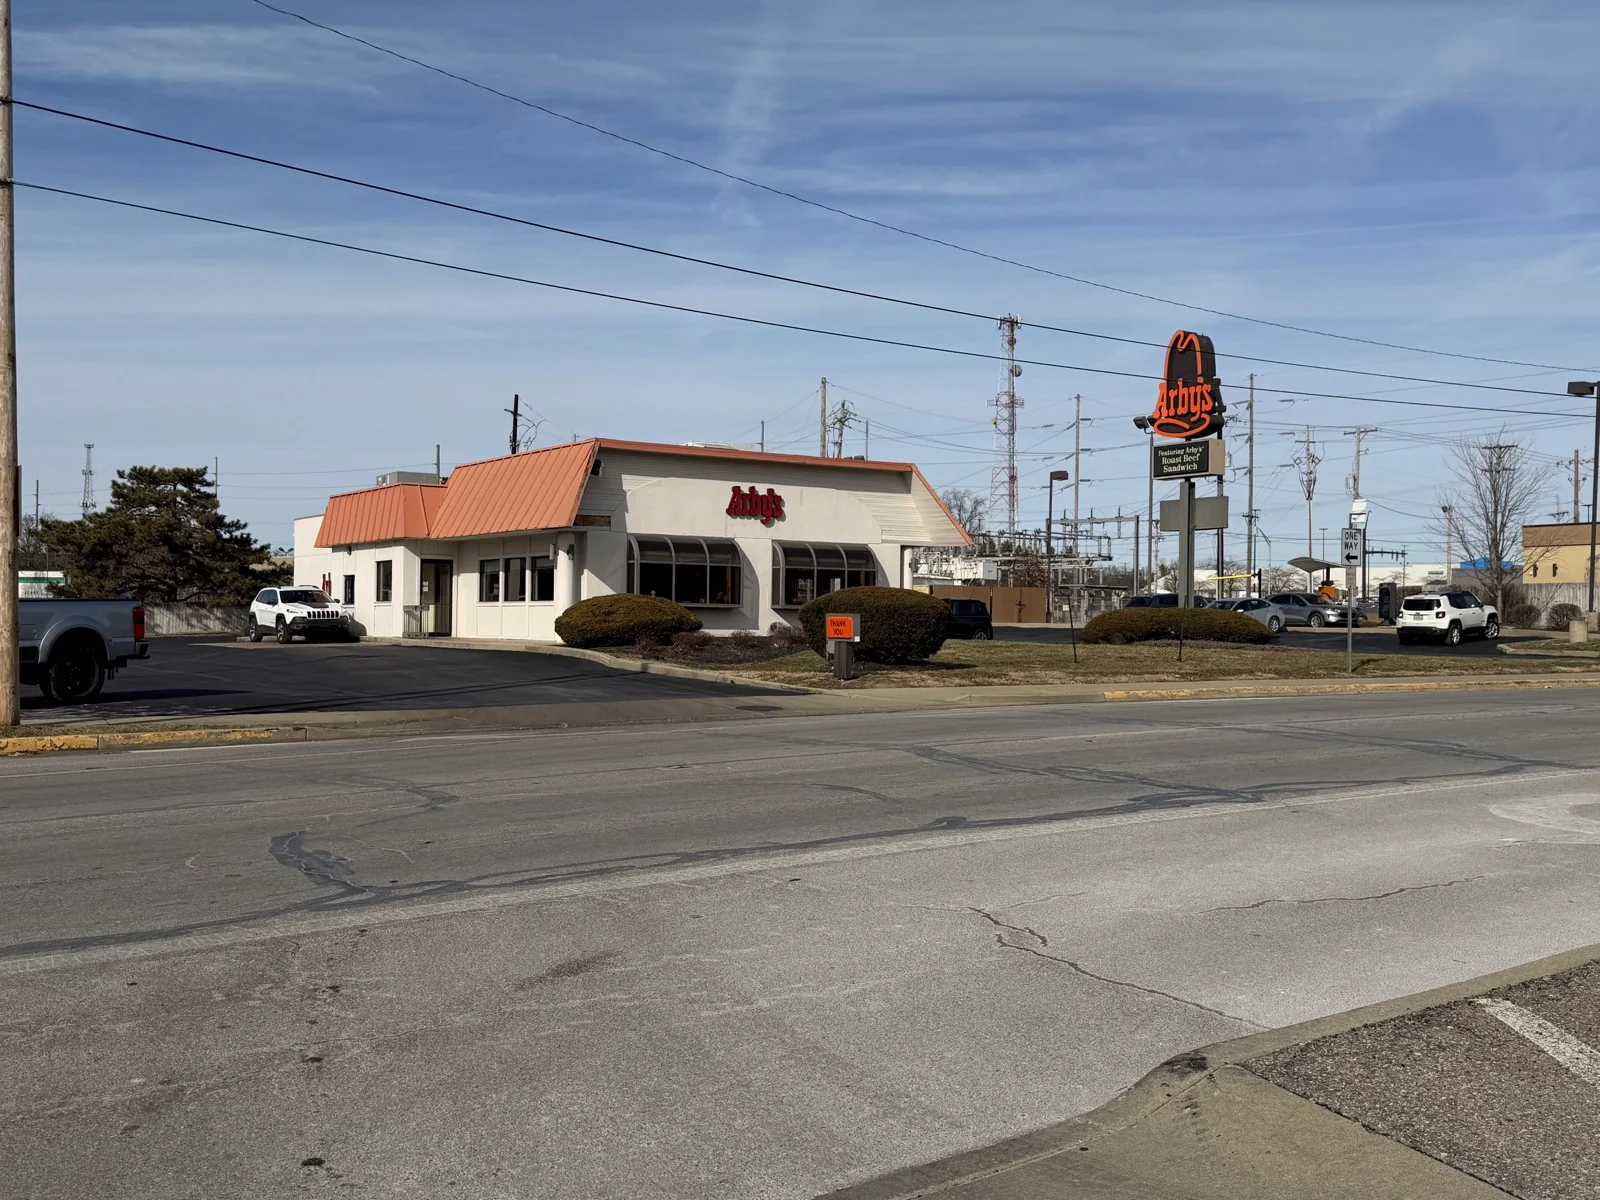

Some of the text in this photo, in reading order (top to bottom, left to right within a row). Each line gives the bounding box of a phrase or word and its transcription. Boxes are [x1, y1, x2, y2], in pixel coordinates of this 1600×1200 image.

[1152, 377, 1213, 422] Arby's
[1158, 446, 1203, 457] Featuring Arby's
[1162, 453, 1201, 465] Roast Beef
[1163, 462, 1198, 473] Sandwich
[726, 485, 785, 526] Arby's
[1344, 531, 1359, 541] ONE
[1344, 541, 1359, 551] WAY
[829, 619, 847, 628] THANK
[832, 628, 844, 636] YOU
